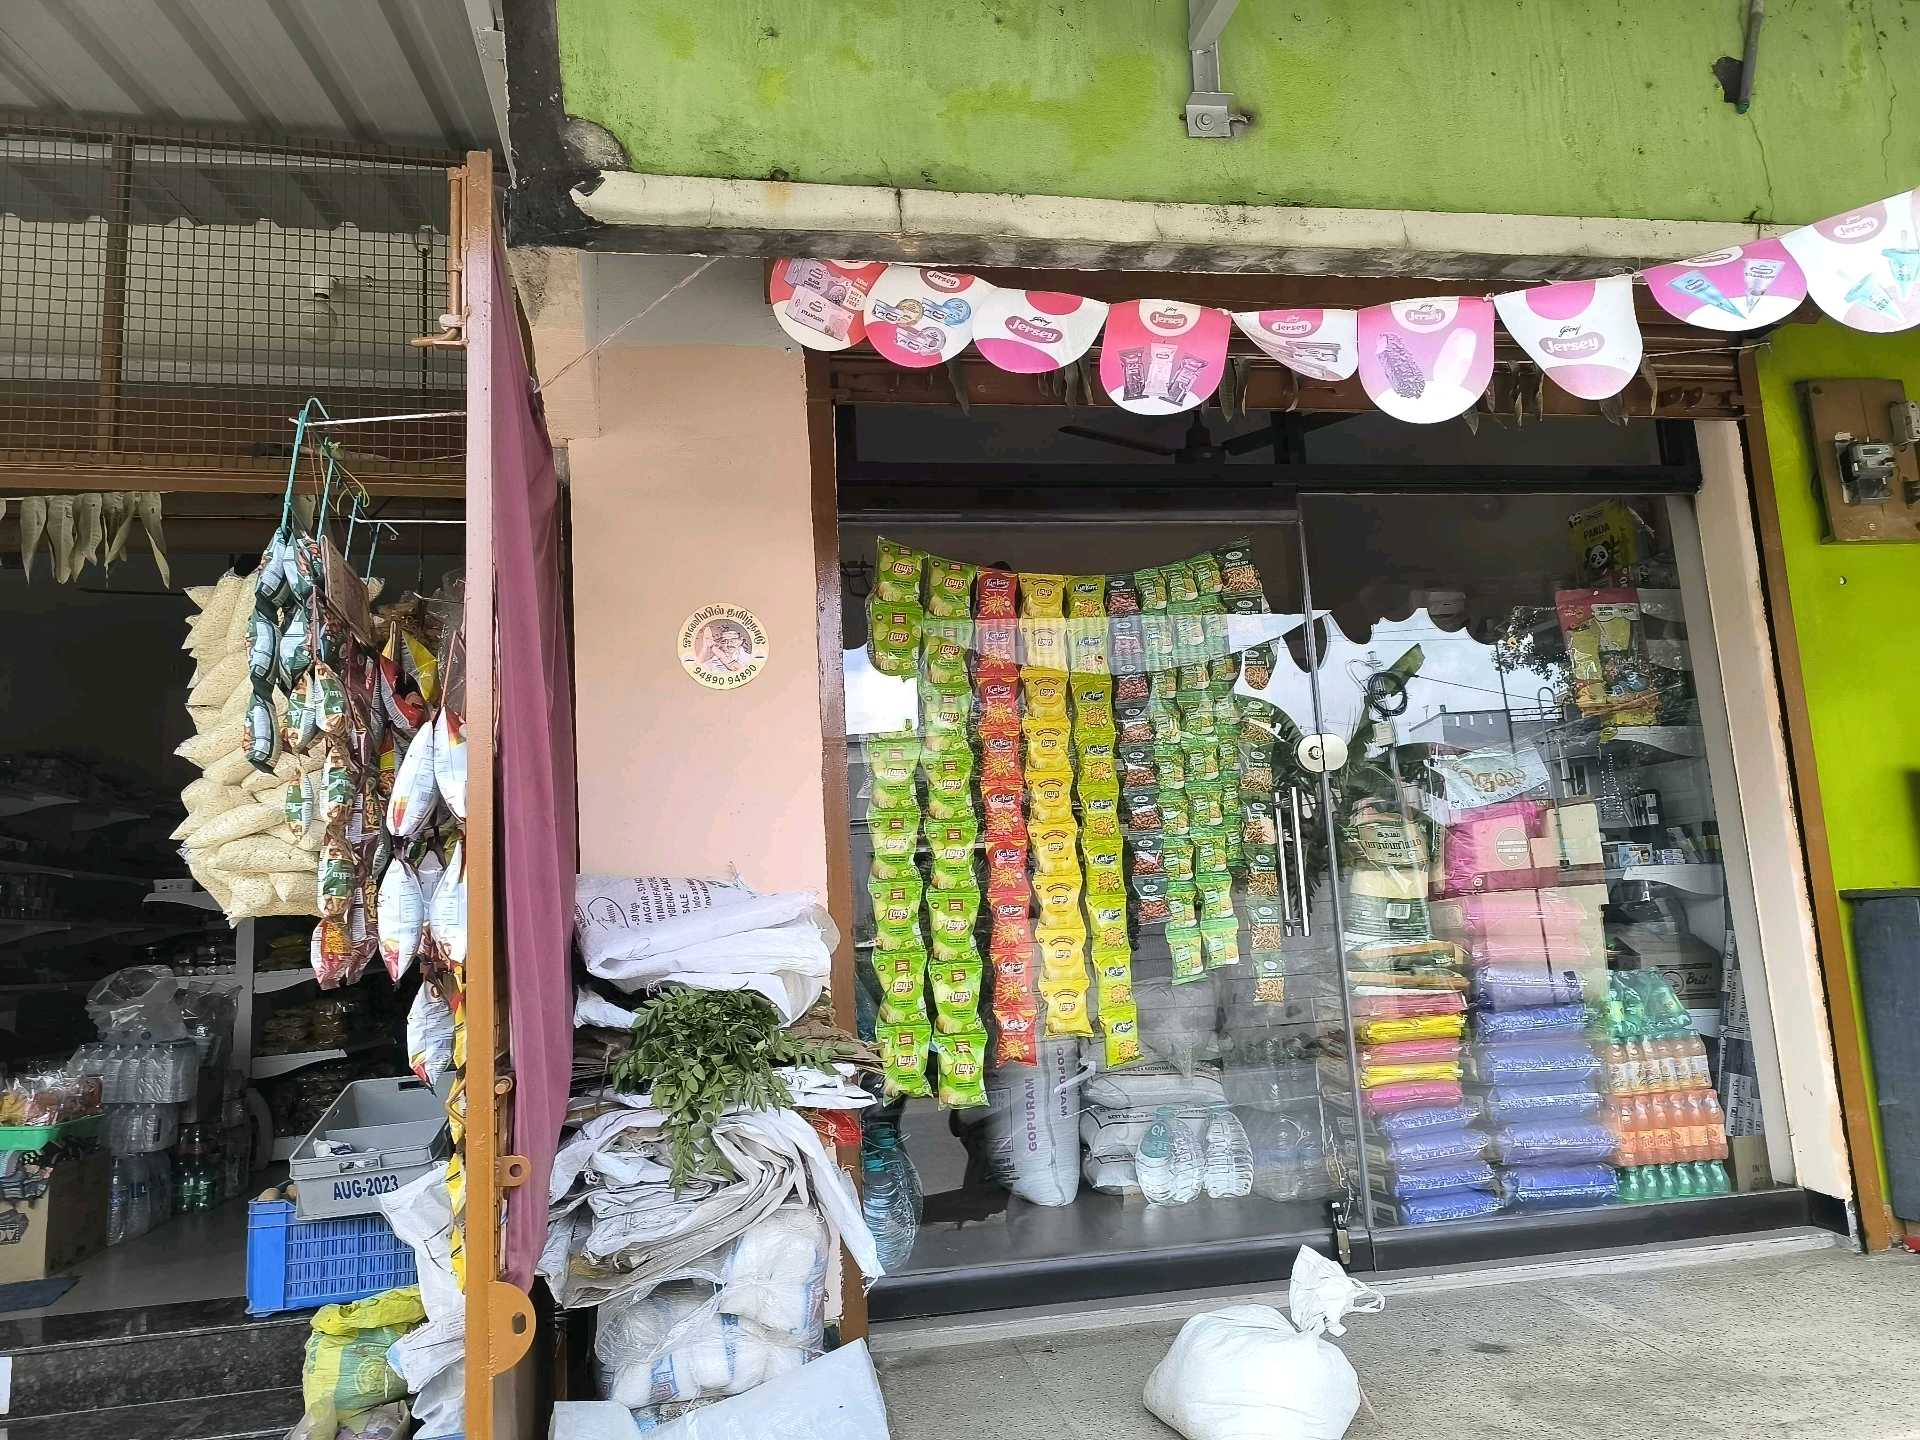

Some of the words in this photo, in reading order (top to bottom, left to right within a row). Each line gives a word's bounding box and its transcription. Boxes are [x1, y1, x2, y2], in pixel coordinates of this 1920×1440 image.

[928, 272, 957, 287] Jersey
[1009, 319, 1059, 342] Jersey
[1151, 313, 1186, 327] Jersey
[1275, 322, 1308, 332] Jersey
[1545, 336, 1600, 354] Jersey
[693, 666, 725, 686] 94890
[727, 664, 757, 685] 94890
[680, 893, 691, 914] SALE
[1024, 1078, 1038, 1152] GOPURAM
[334, 1174, 399, 1201] AUG-2023
